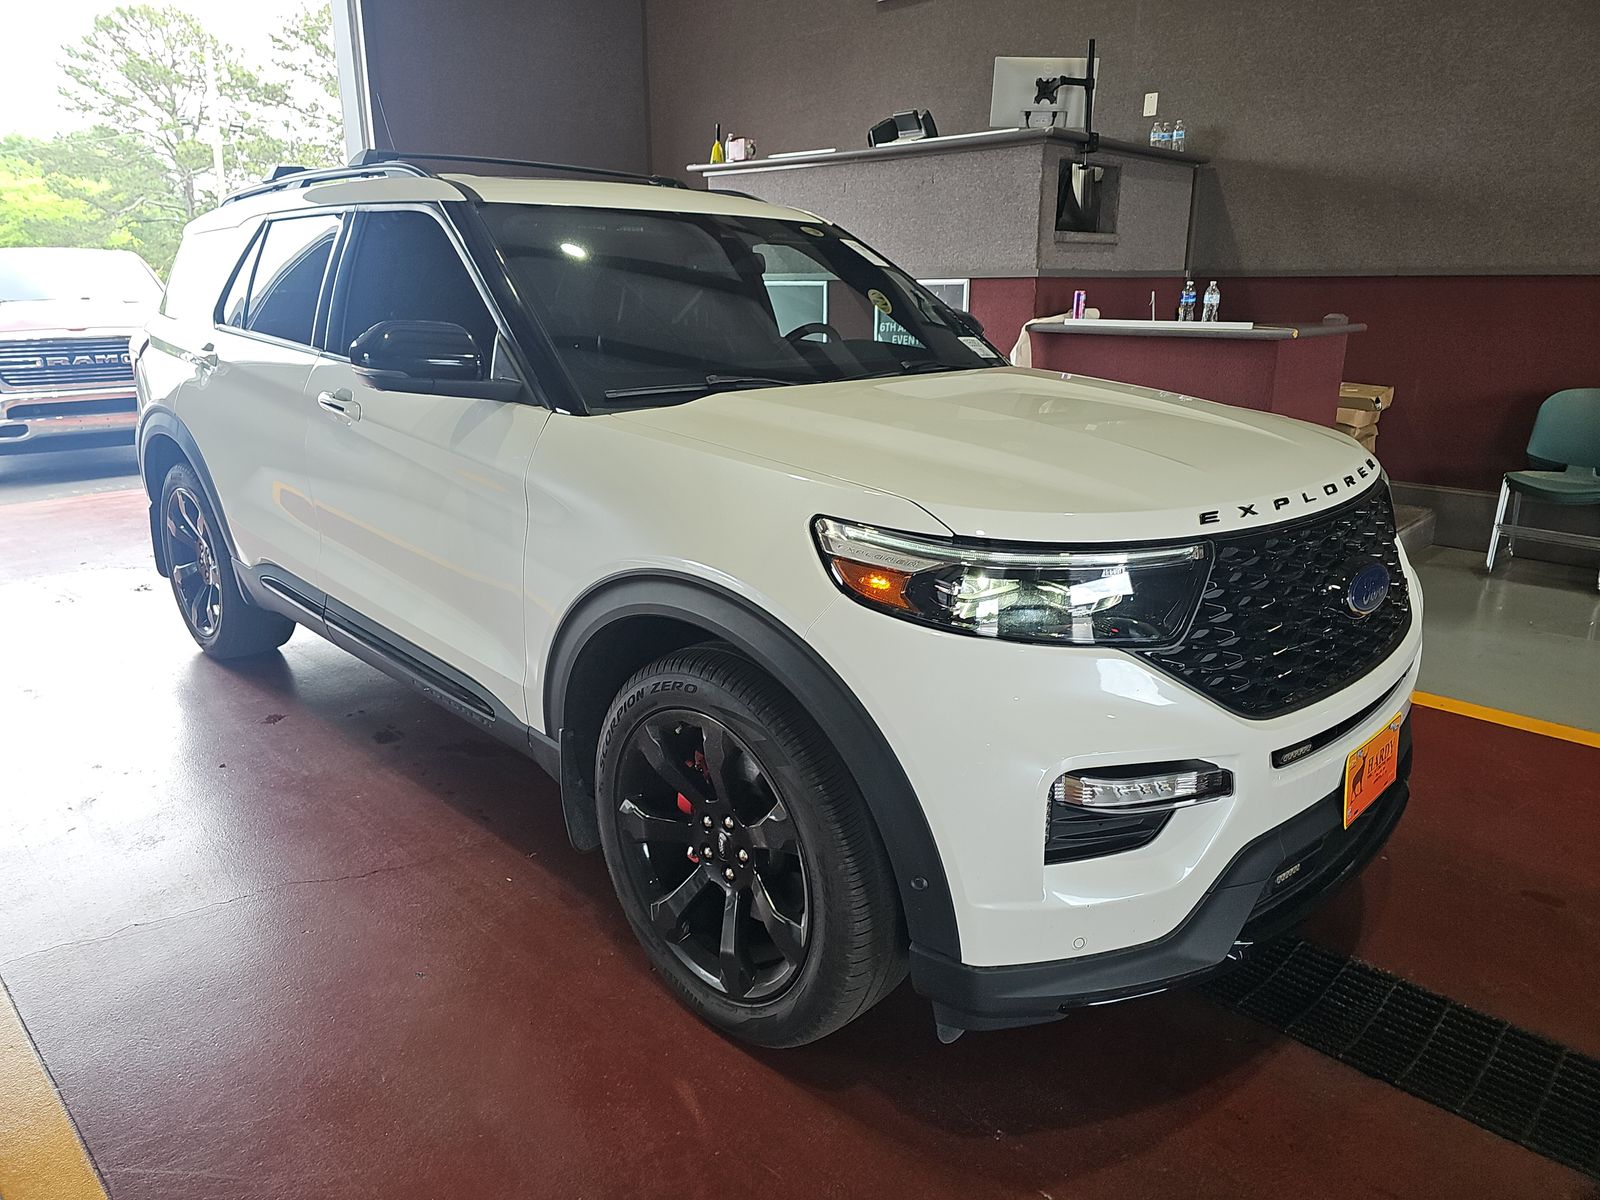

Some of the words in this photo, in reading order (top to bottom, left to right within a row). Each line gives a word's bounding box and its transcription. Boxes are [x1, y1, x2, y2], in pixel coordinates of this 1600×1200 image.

[879, 321, 897, 333] 6TH
[46, 354, 119, 367] RAM
[1199, 458, 1376, 525] EXPLORER
[600, 687, 645, 774] SCORPION
[650, 680, 698, 695] ZERO
[1367, 740, 1394, 775] HARDY
